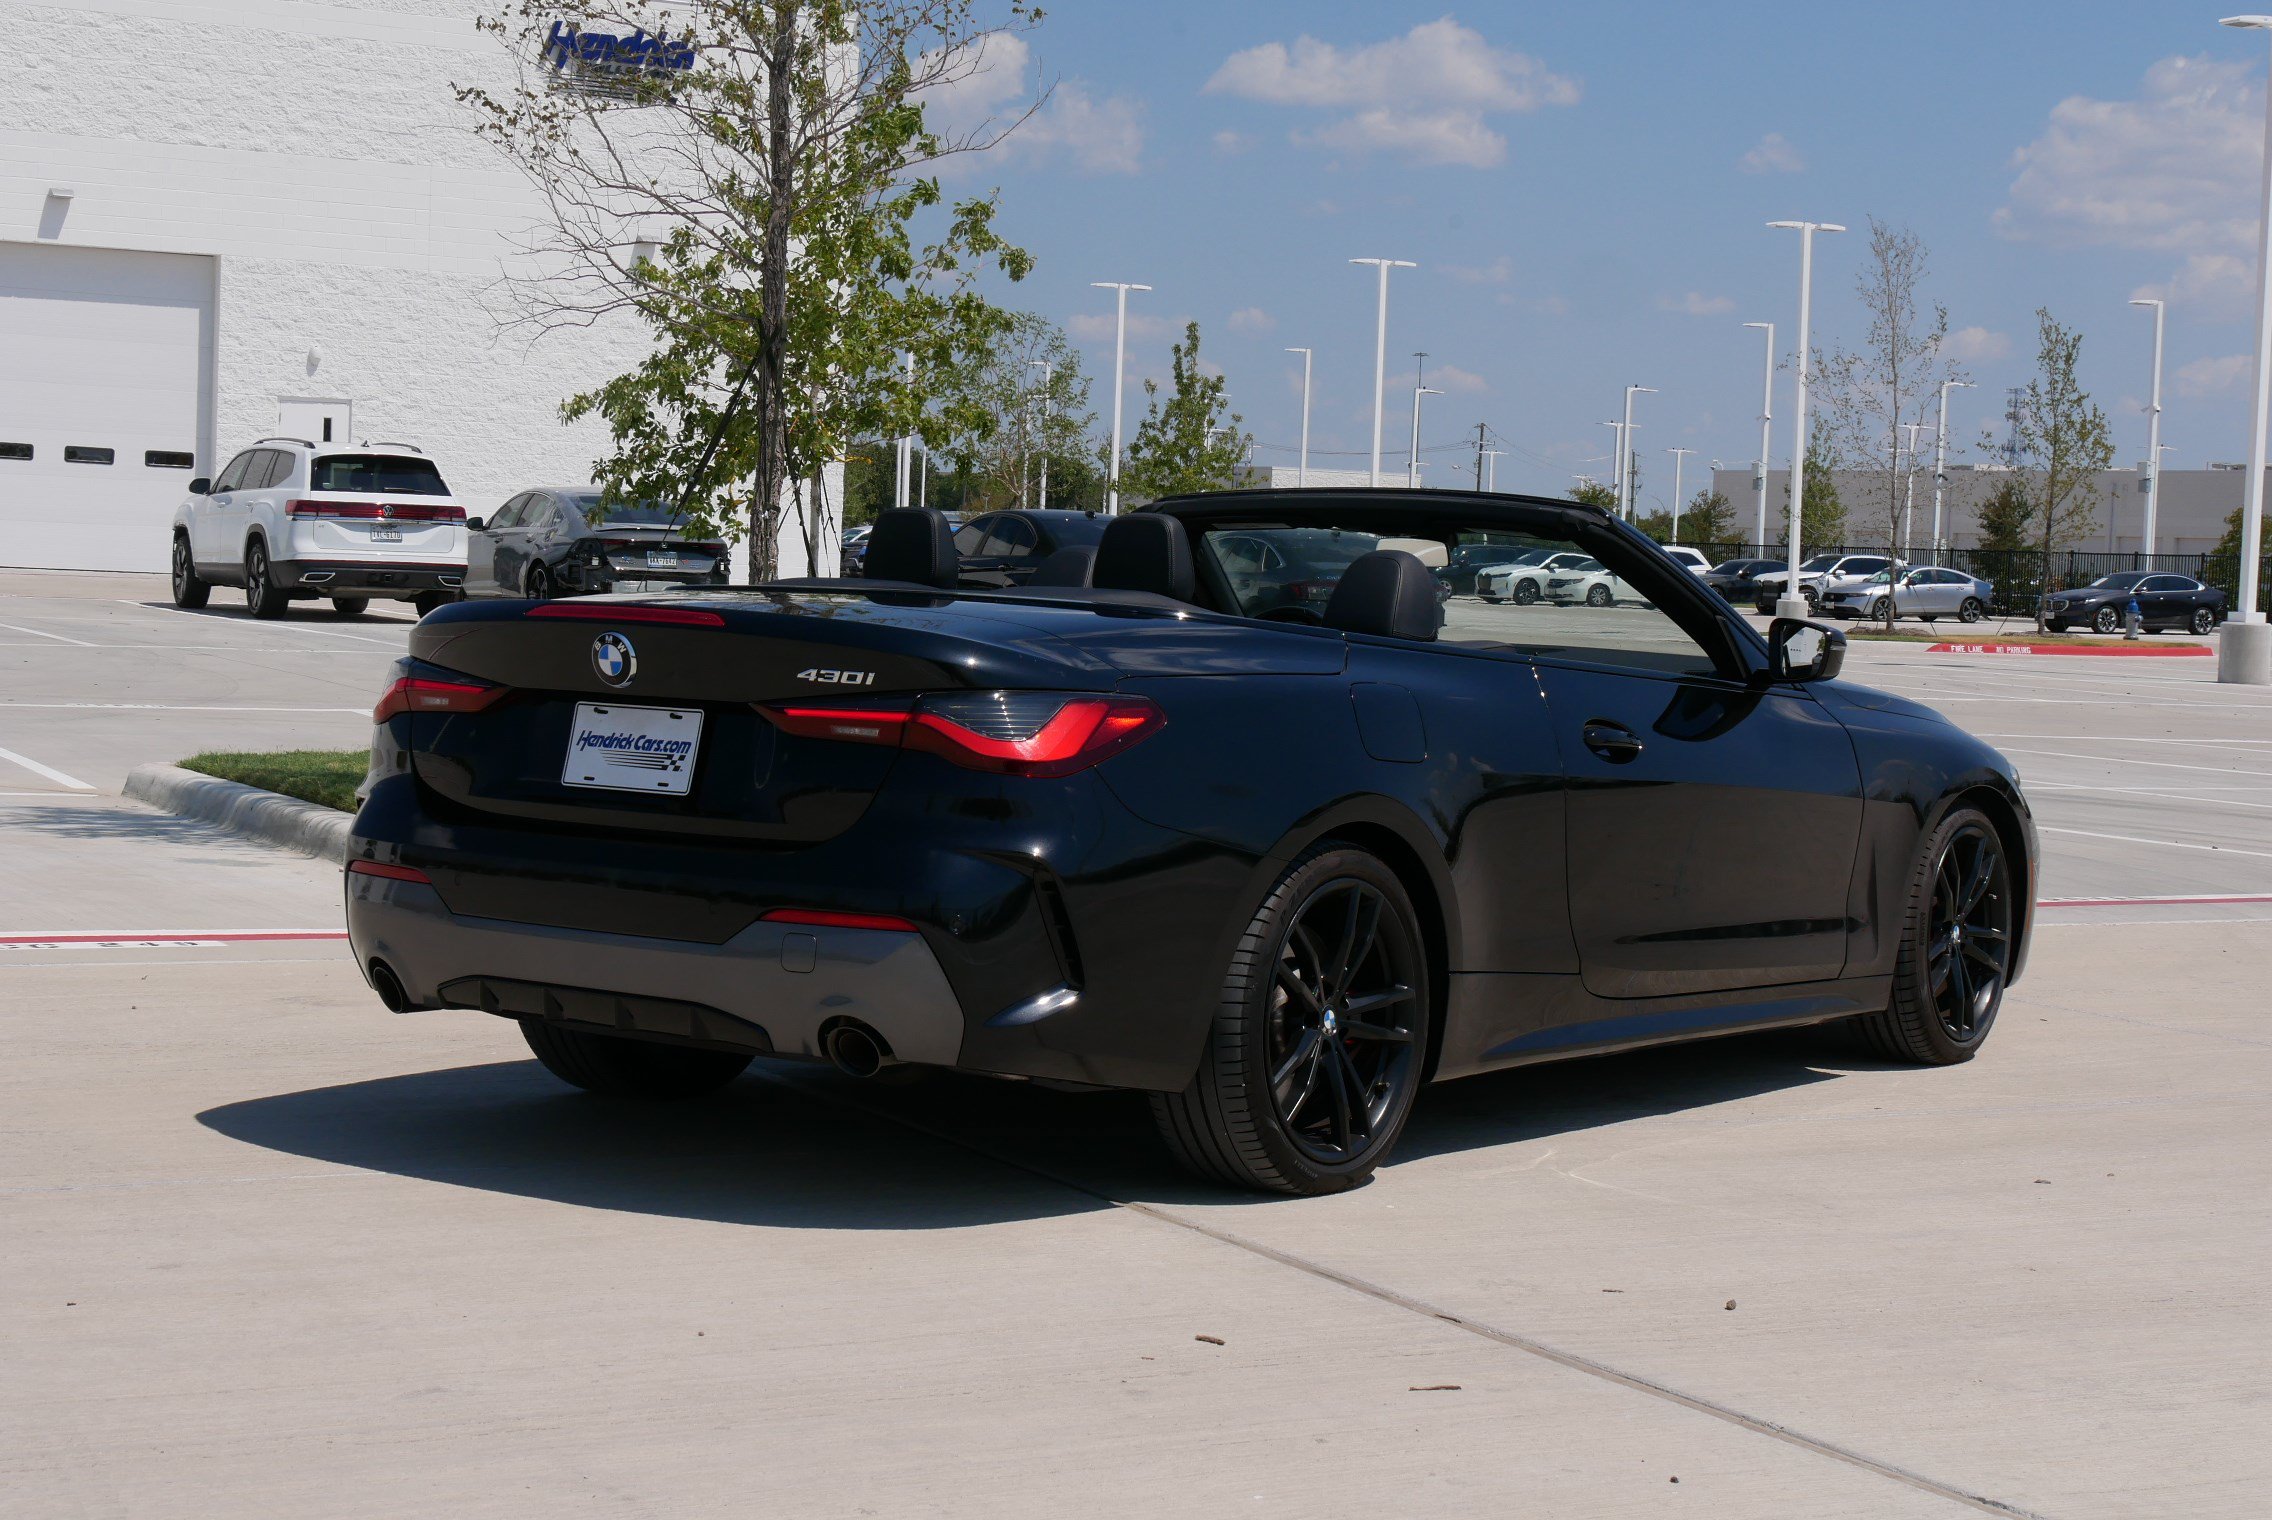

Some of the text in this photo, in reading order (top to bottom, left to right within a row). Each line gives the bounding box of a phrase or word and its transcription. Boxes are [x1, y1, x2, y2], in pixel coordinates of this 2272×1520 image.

[594, 635, 627, 653] BMW
[1951, 645, 1965, 653] FIRE
[1968, 645, 1984, 653] LANE
[2006, 646, 2032, 654] PARKING
